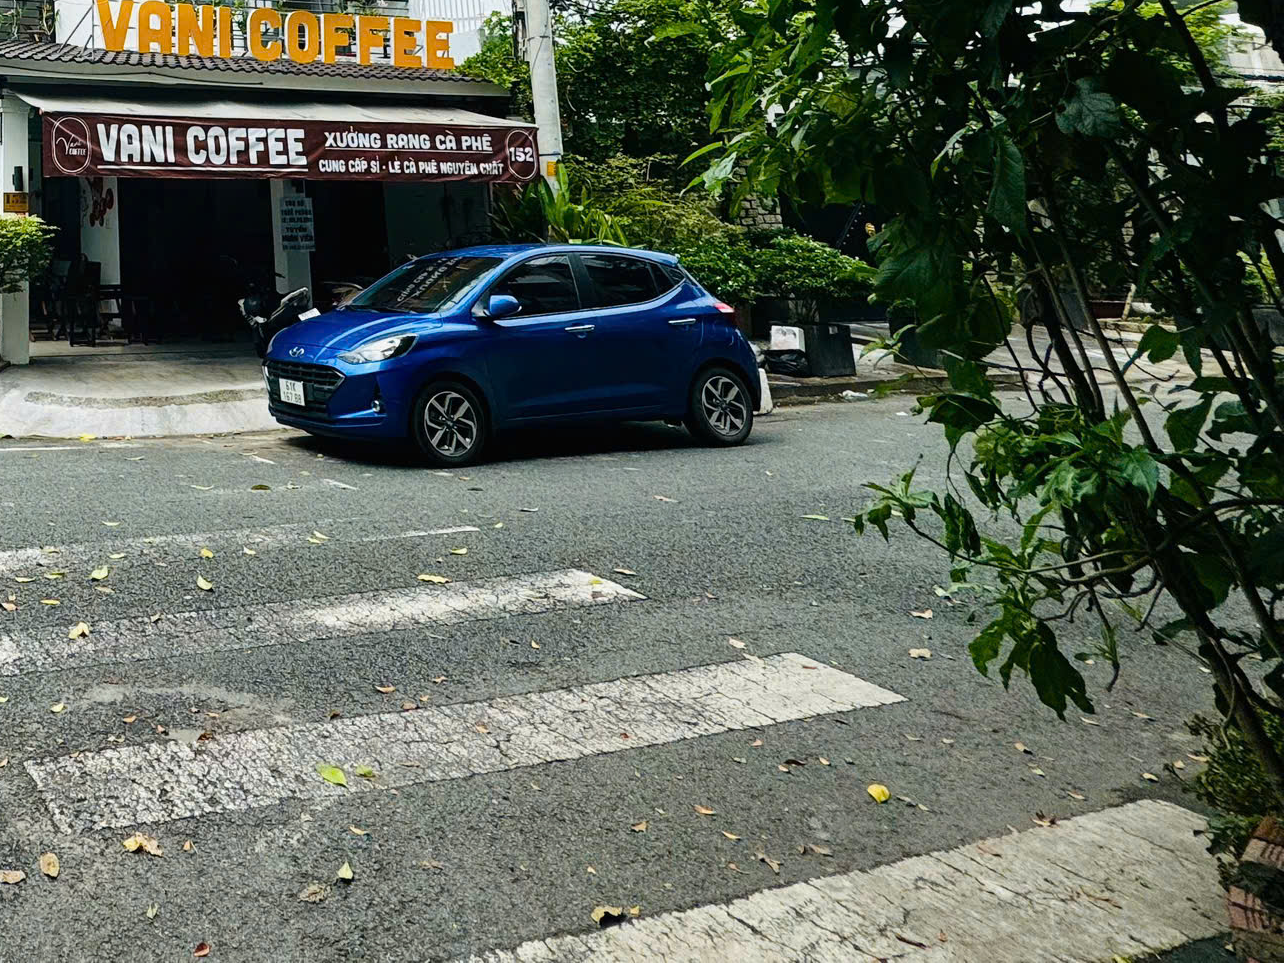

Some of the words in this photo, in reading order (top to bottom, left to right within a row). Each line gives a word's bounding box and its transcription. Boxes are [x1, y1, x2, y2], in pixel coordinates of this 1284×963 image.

[246, 7, 455, 70] COFFEE
[96, 123, 176, 163] VANI
[186, 126, 309, 166] COFFEE
[324, 125, 382, 149] XƯỞNG
[386, 132, 431, 150] RANG
[435, 129, 457, 151] CÀ
[461, 133, 493, 152] PHÊ
[69, 147, 87, 156] COFFEE
[509, 146, 534, 163] 152
[318, 159, 347, 173] CUNG
[348, 156, 368, 173] CẤP
[403, 156, 417, 174] CÀ
[418, 159, 438, 175] PHÊ
[439, 160, 479, 175] NGUYÊN
[479, 159, 505, 175] CHẤT
